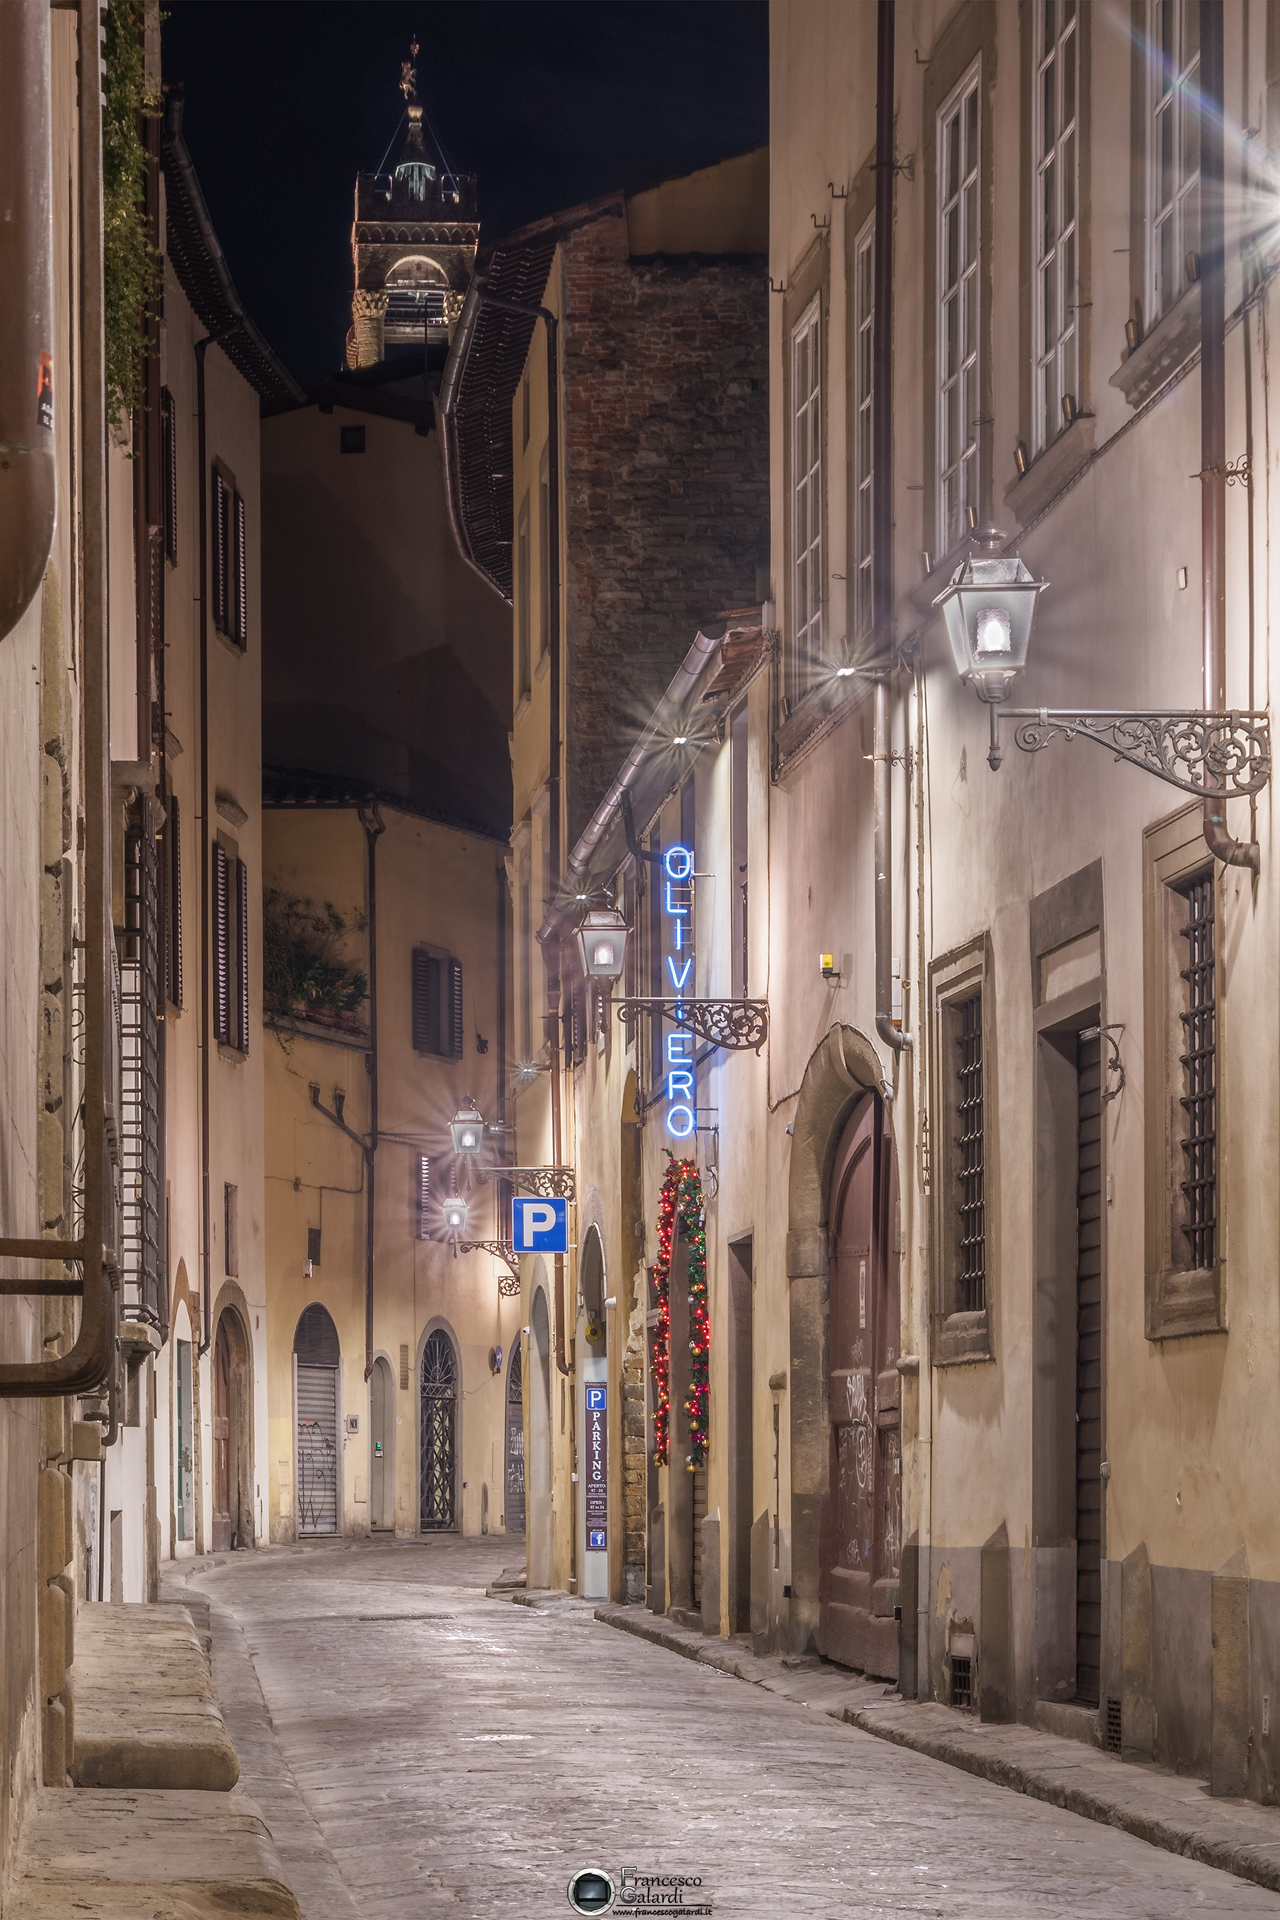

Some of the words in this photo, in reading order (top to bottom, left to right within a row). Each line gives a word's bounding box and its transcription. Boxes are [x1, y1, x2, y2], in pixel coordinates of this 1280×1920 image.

[523, 1203, 557, 1247] P
[591, 1391, 602, 1407] P
[592, 1412, 602, 1481] PARKING
